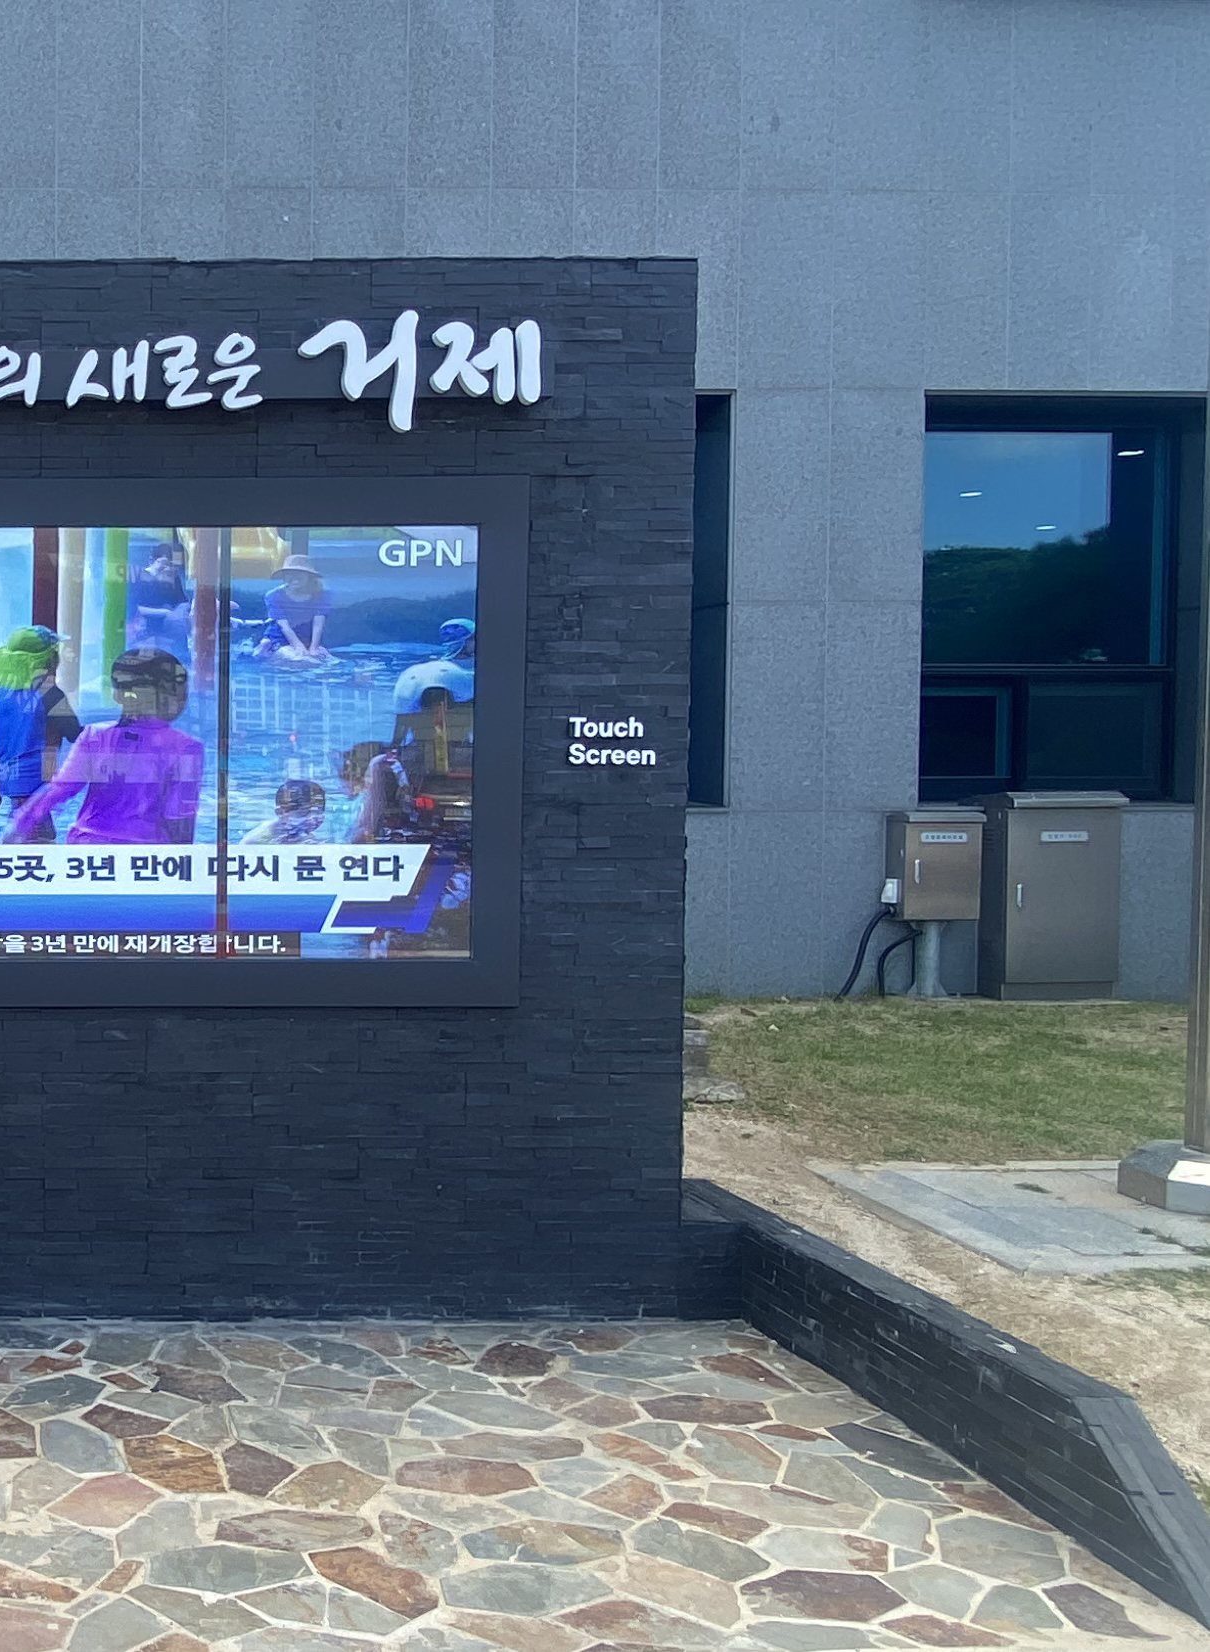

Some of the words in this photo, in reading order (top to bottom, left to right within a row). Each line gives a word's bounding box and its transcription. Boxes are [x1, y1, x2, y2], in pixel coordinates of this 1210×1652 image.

[65, 331, 264, 411] 새로운
[297, 309, 542, 433] 거제
[378, 539, 462, 567] GPN
[568, 716, 644, 738] Touch
[568, 743, 656, 765] Screen
[66, 854, 116, 882] 3년
[130, 854, 192, 882] 만에
[207, 854, 280, 882] 다시
[293, 855, 326, 882] 문
[338, 854, 405, 882] 연다
[30, 934, 66, 953] 3년
[72, 934, 119, 953] 만에
